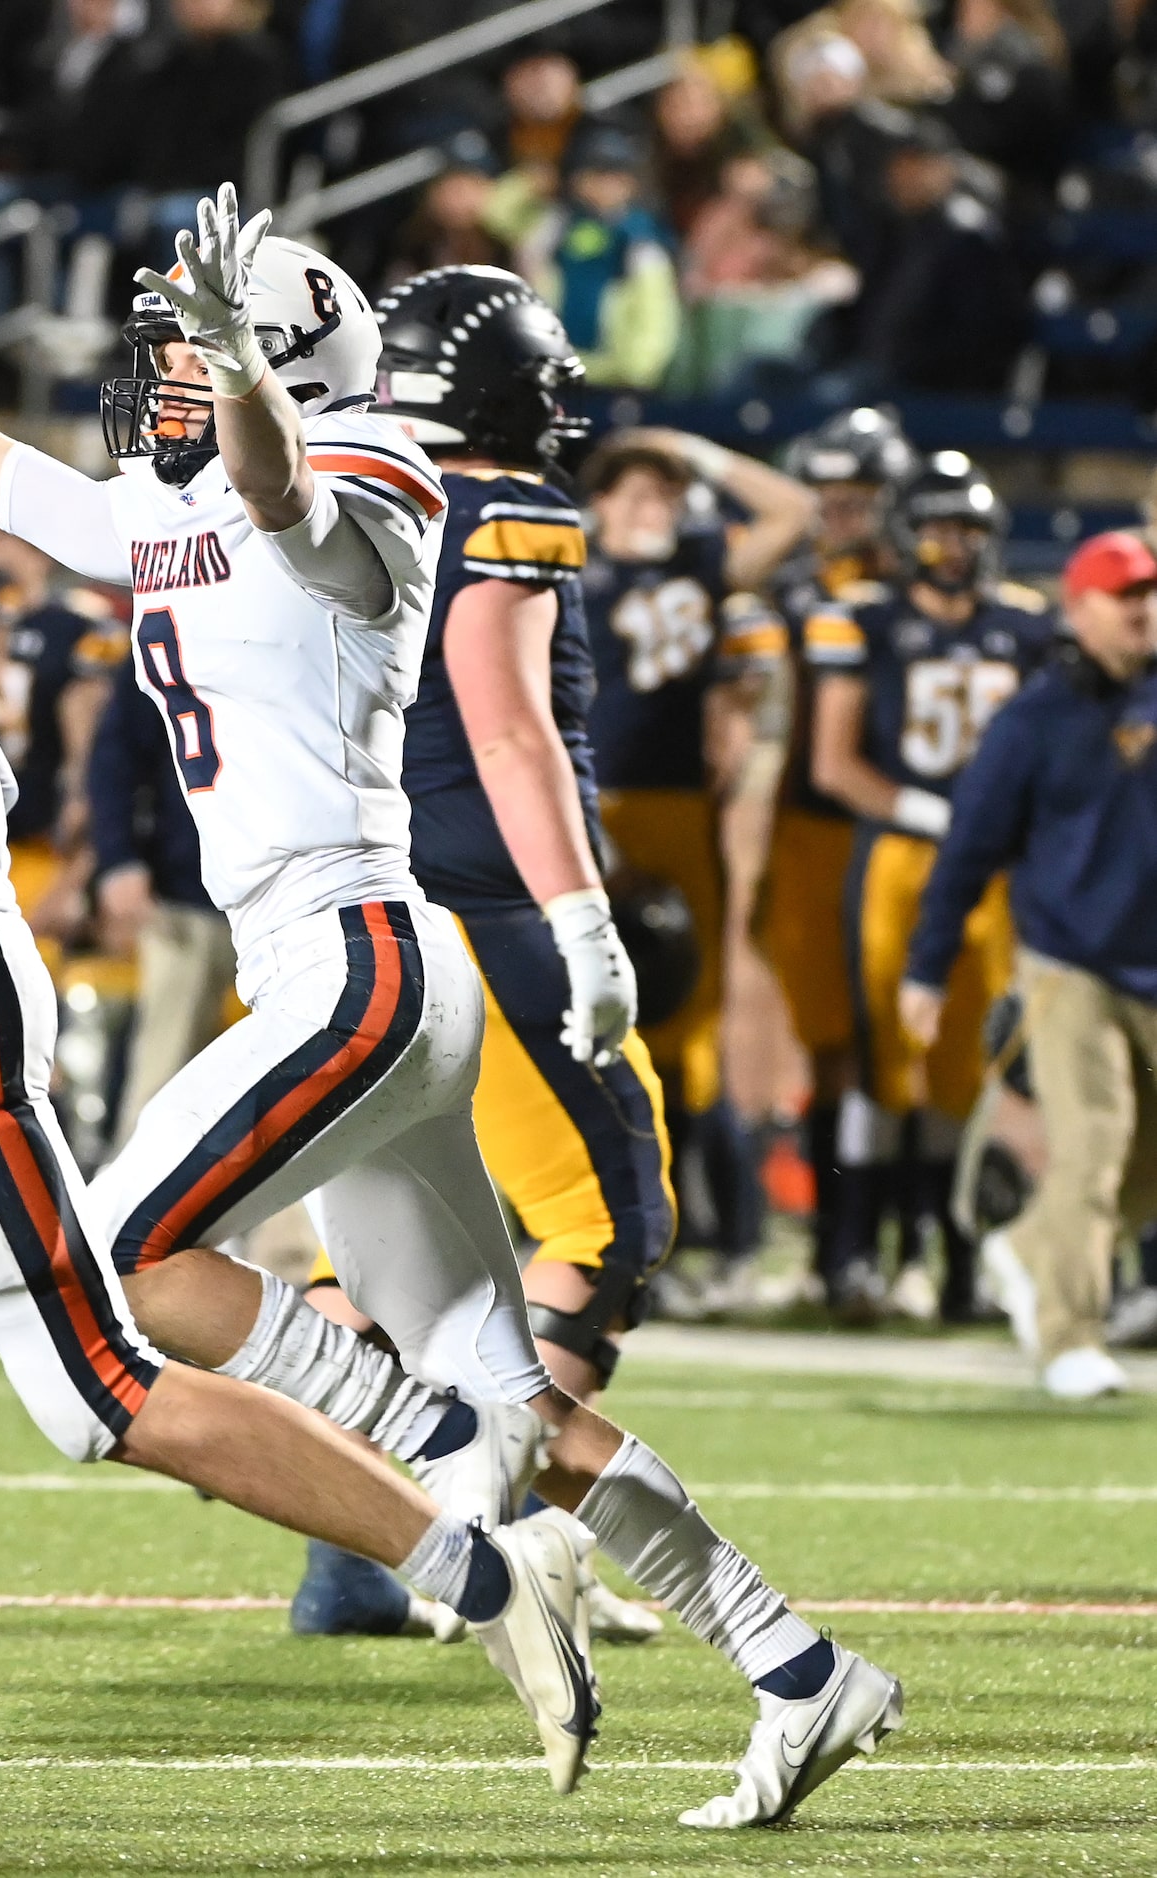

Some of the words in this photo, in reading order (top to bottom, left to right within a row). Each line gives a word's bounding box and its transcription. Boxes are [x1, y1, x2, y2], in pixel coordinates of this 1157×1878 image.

[141, 295, 161, 307] TEAM
[304, 268, 342, 323] 8
[137, 605, 223, 795] 8
